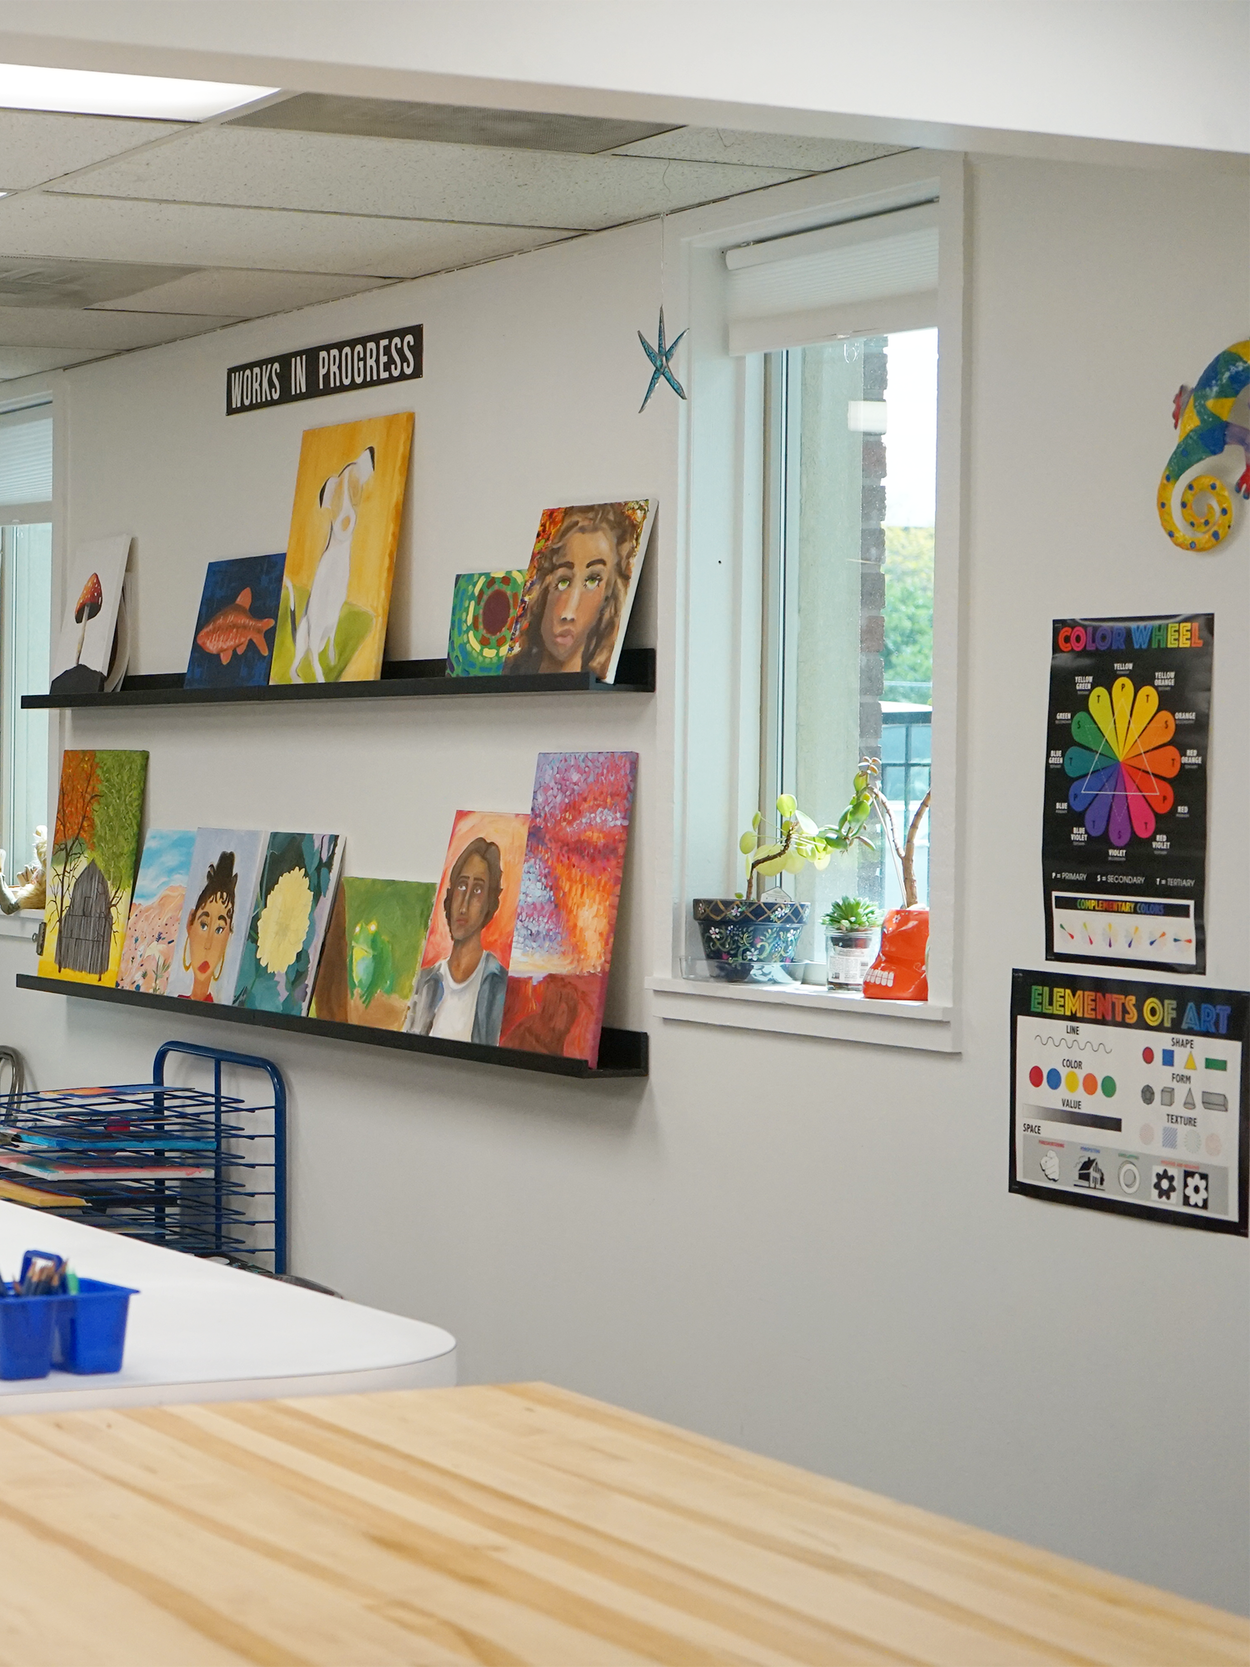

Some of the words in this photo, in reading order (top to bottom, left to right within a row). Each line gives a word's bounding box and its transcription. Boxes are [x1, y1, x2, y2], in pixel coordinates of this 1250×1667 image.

[231, 362, 280, 408] WORKS
[291, 354, 307, 395] IN
[319, 334, 415, 389] PROGRESS
[1058, 626, 1126, 651] COLOR
[1131, 622, 1204, 649] WHEEL
[1154, 671, 1175, 679] YELLOW
[1121, 683, 1125, 692] P
[1056, 712, 1072, 720] GREEN
[1175, 712, 1196, 720] ORANGE
[1077, 720, 1081, 729] S
[1164, 720, 1169, 729] S
[1186, 749, 1198, 757] RED
[1181, 756, 1202, 764] ORANGE
[1177, 805, 1188, 813] RED
[1152, 841, 1170, 849] VIOLET
[1108, 849, 1126, 857] VIOLET
[1061, 872, 1087, 881] PRIMARY
[1107, 874, 1146, 884] SECONDARY
[1167, 877, 1196, 887] TERTIARY
[1076, 899, 1135, 913] COMPLEMENTARY
[1136, 903, 1165, 915] COLORS
[1030, 985, 1138, 1024] ELEMENTS
[1143, 997, 1177, 1027] OF
[1181, 1002, 1232, 1034] ART
[1065, 1025, 1080, 1036] LINE
[1171, 1037, 1195, 1049] SHAPE
[1061, 1058, 1083, 1070] COLOR
[1171, 1073, 1192, 1085] FORM
[1061, 1098, 1082, 1110] VALUE
[1166, 1113, 1198, 1127] TEXTURE
[1022, 1123, 1041, 1134] SPACE
